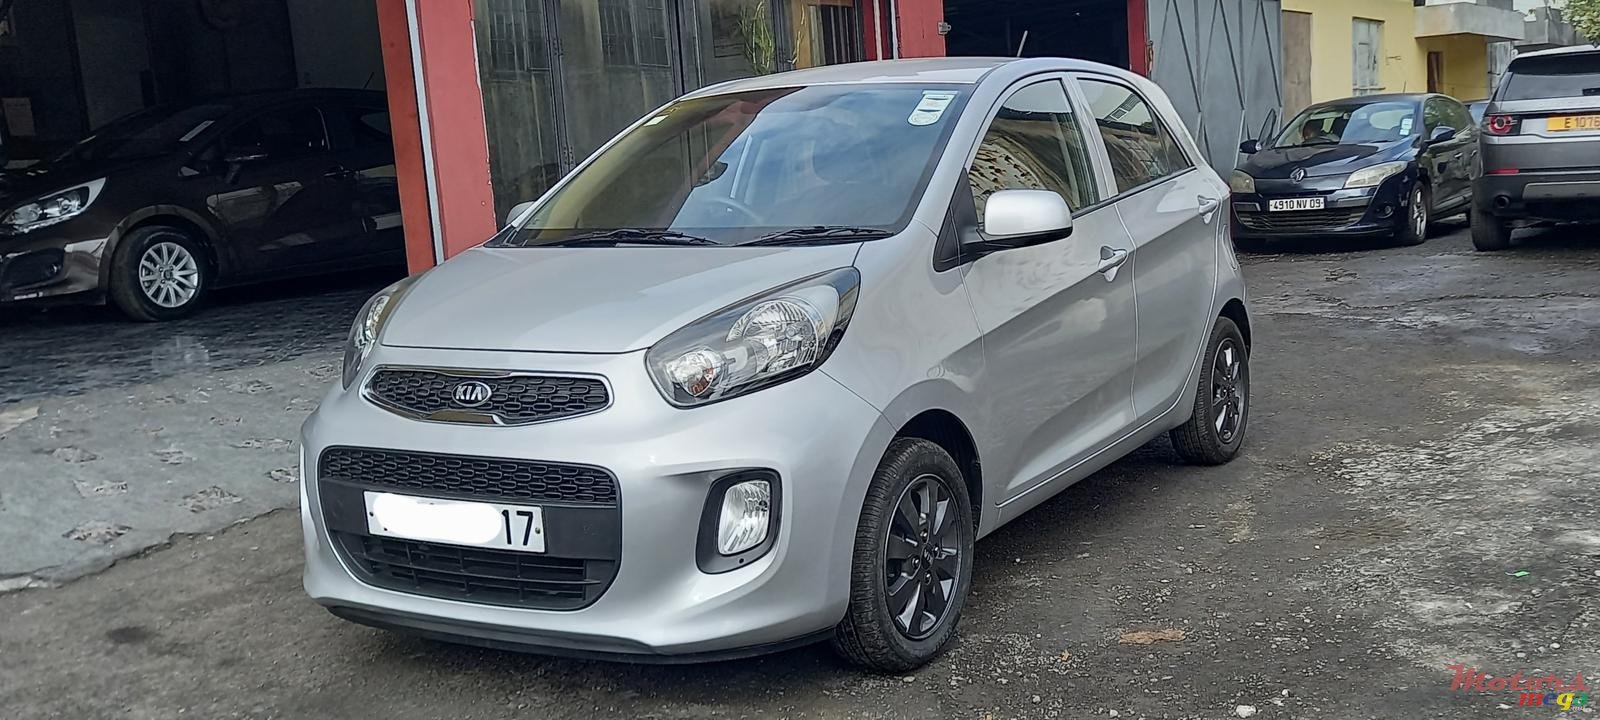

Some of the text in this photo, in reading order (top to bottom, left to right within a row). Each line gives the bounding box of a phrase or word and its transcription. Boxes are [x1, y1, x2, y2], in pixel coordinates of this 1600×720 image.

[1564, 117, 1571, 128] E
[1273, 198, 1321, 210] 4910 NV 09
[455, 385, 483, 401] KIA
[501, 509, 534, 546] 17
